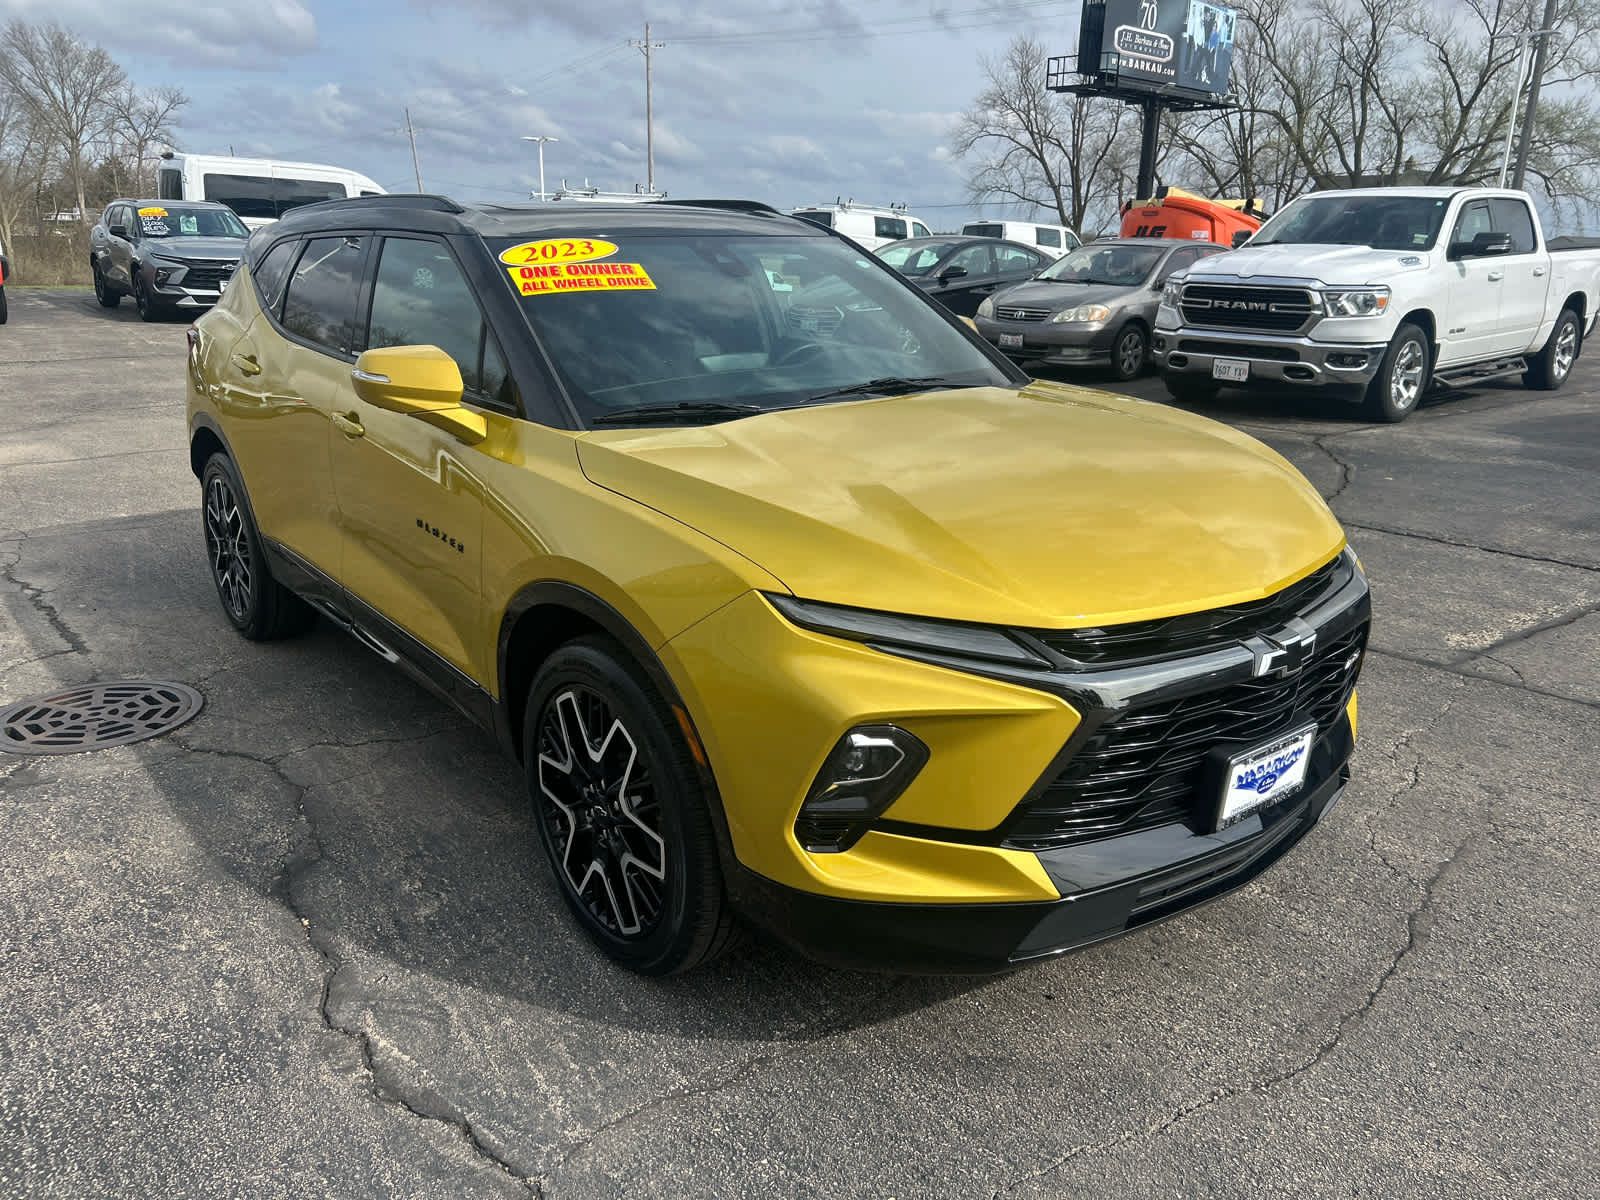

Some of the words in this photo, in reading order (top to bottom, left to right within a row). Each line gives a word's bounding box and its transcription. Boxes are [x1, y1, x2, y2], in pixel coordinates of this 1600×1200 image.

[1140, 2, 1157, 30] 70
[1131, 225, 1168, 238] JLG
[521, 240, 595, 263] 2023
[519, 265, 562, 280] ONE
[566, 264, 635, 277] OWNER
[522, 281, 549, 293] ALL
[553, 277, 603, 289] WHEEL
[608, 276, 649, 288] DRIVE
[1214, 300, 1267, 311] RAM
[416, 518, 464, 554] BLAZER
